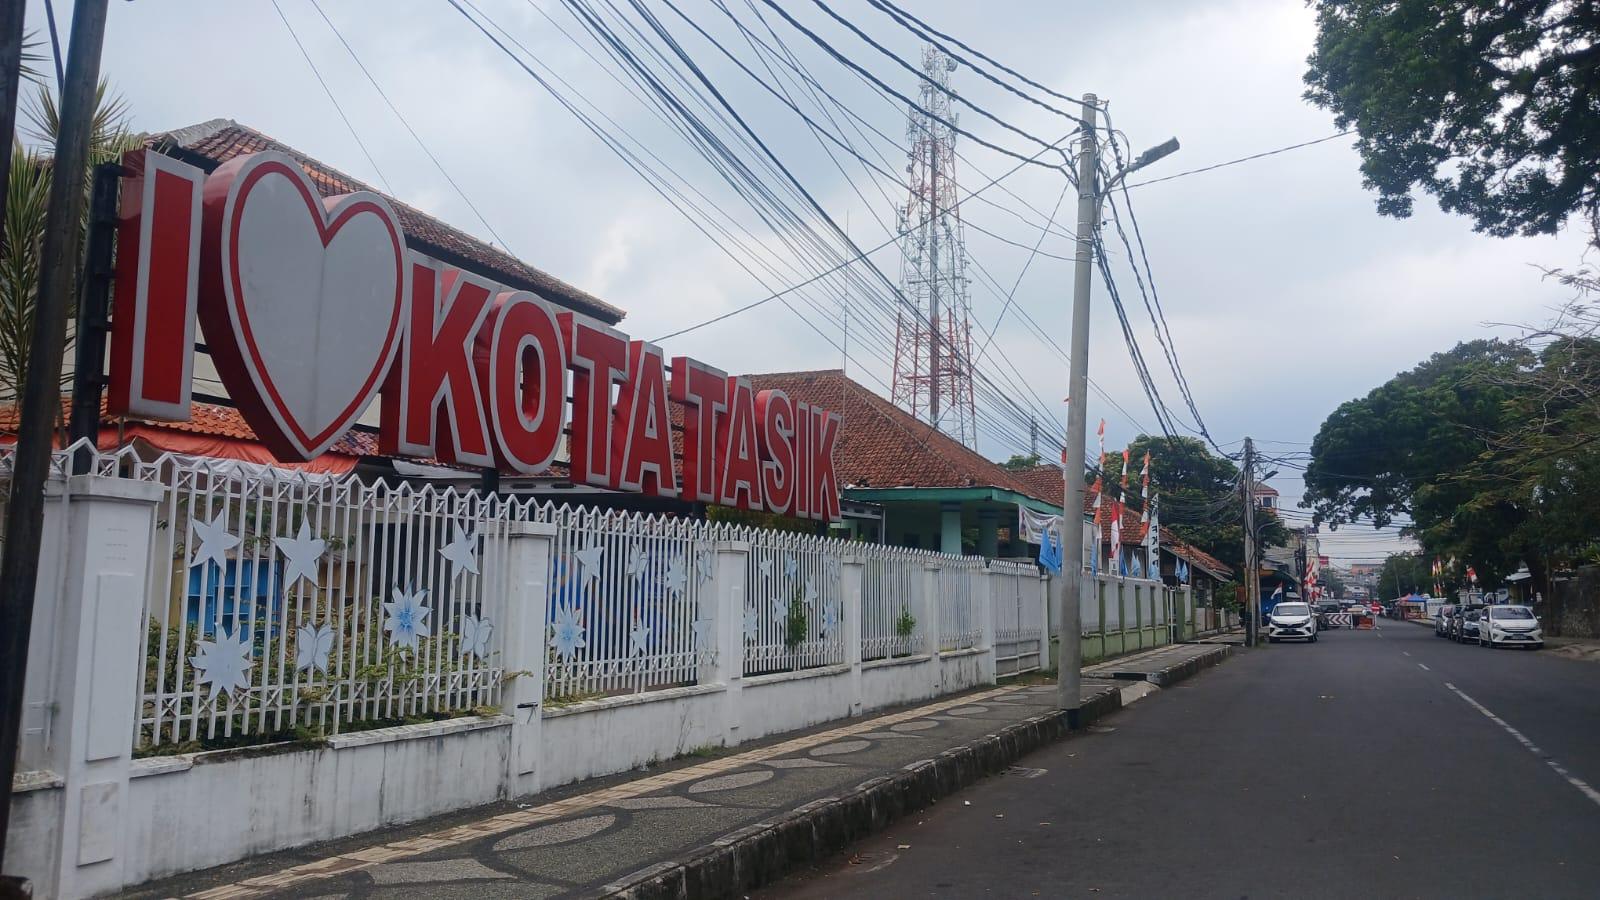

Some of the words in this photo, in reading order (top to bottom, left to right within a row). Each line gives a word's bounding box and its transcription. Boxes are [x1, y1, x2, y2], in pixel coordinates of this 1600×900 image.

[128, 148, 205, 422] I
[399, 247, 678, 498] KOTA
[680, 358, 843, 523] TASIK
